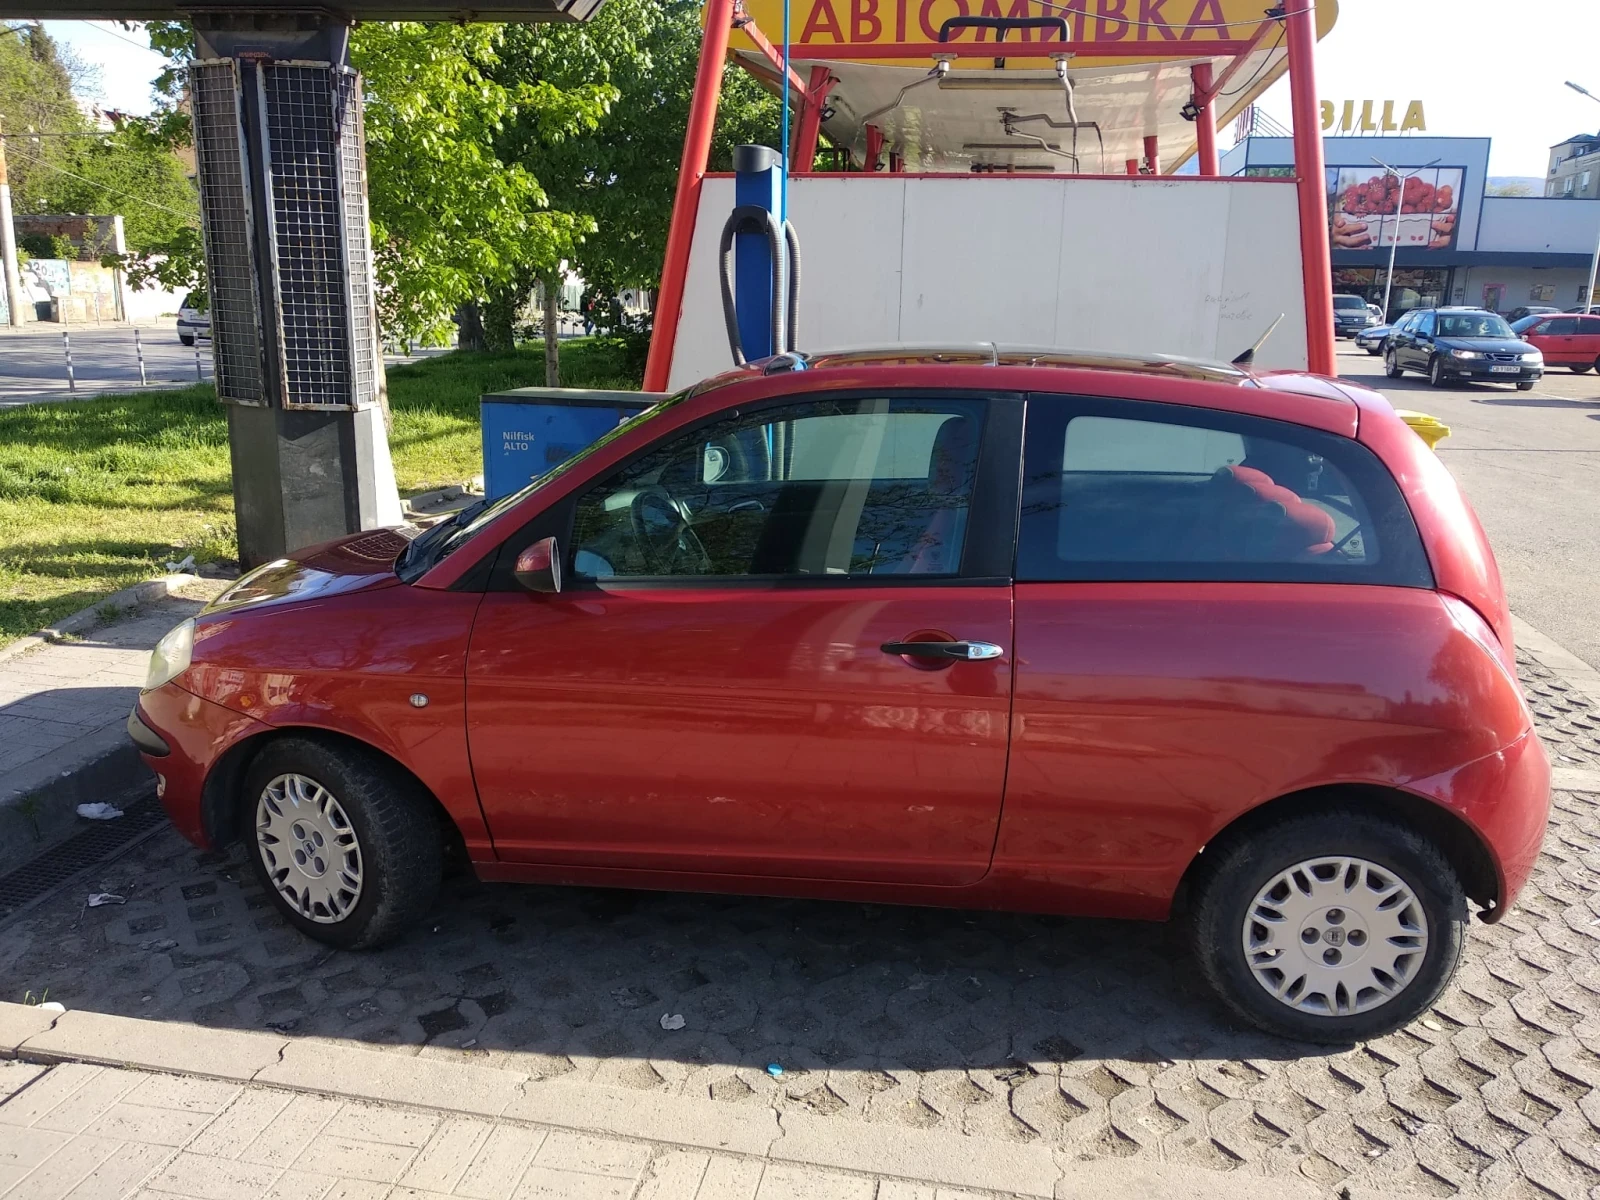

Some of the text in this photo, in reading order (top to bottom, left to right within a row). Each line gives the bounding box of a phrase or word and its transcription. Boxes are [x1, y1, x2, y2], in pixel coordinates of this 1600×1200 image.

[799, 0, 1231, 43] АВТОМИВКА
[1320, 100, 1427, 131] BILLA
[502, 431, 535, 441] Nilfisk
[503, 442, 529, 451] ALTO
